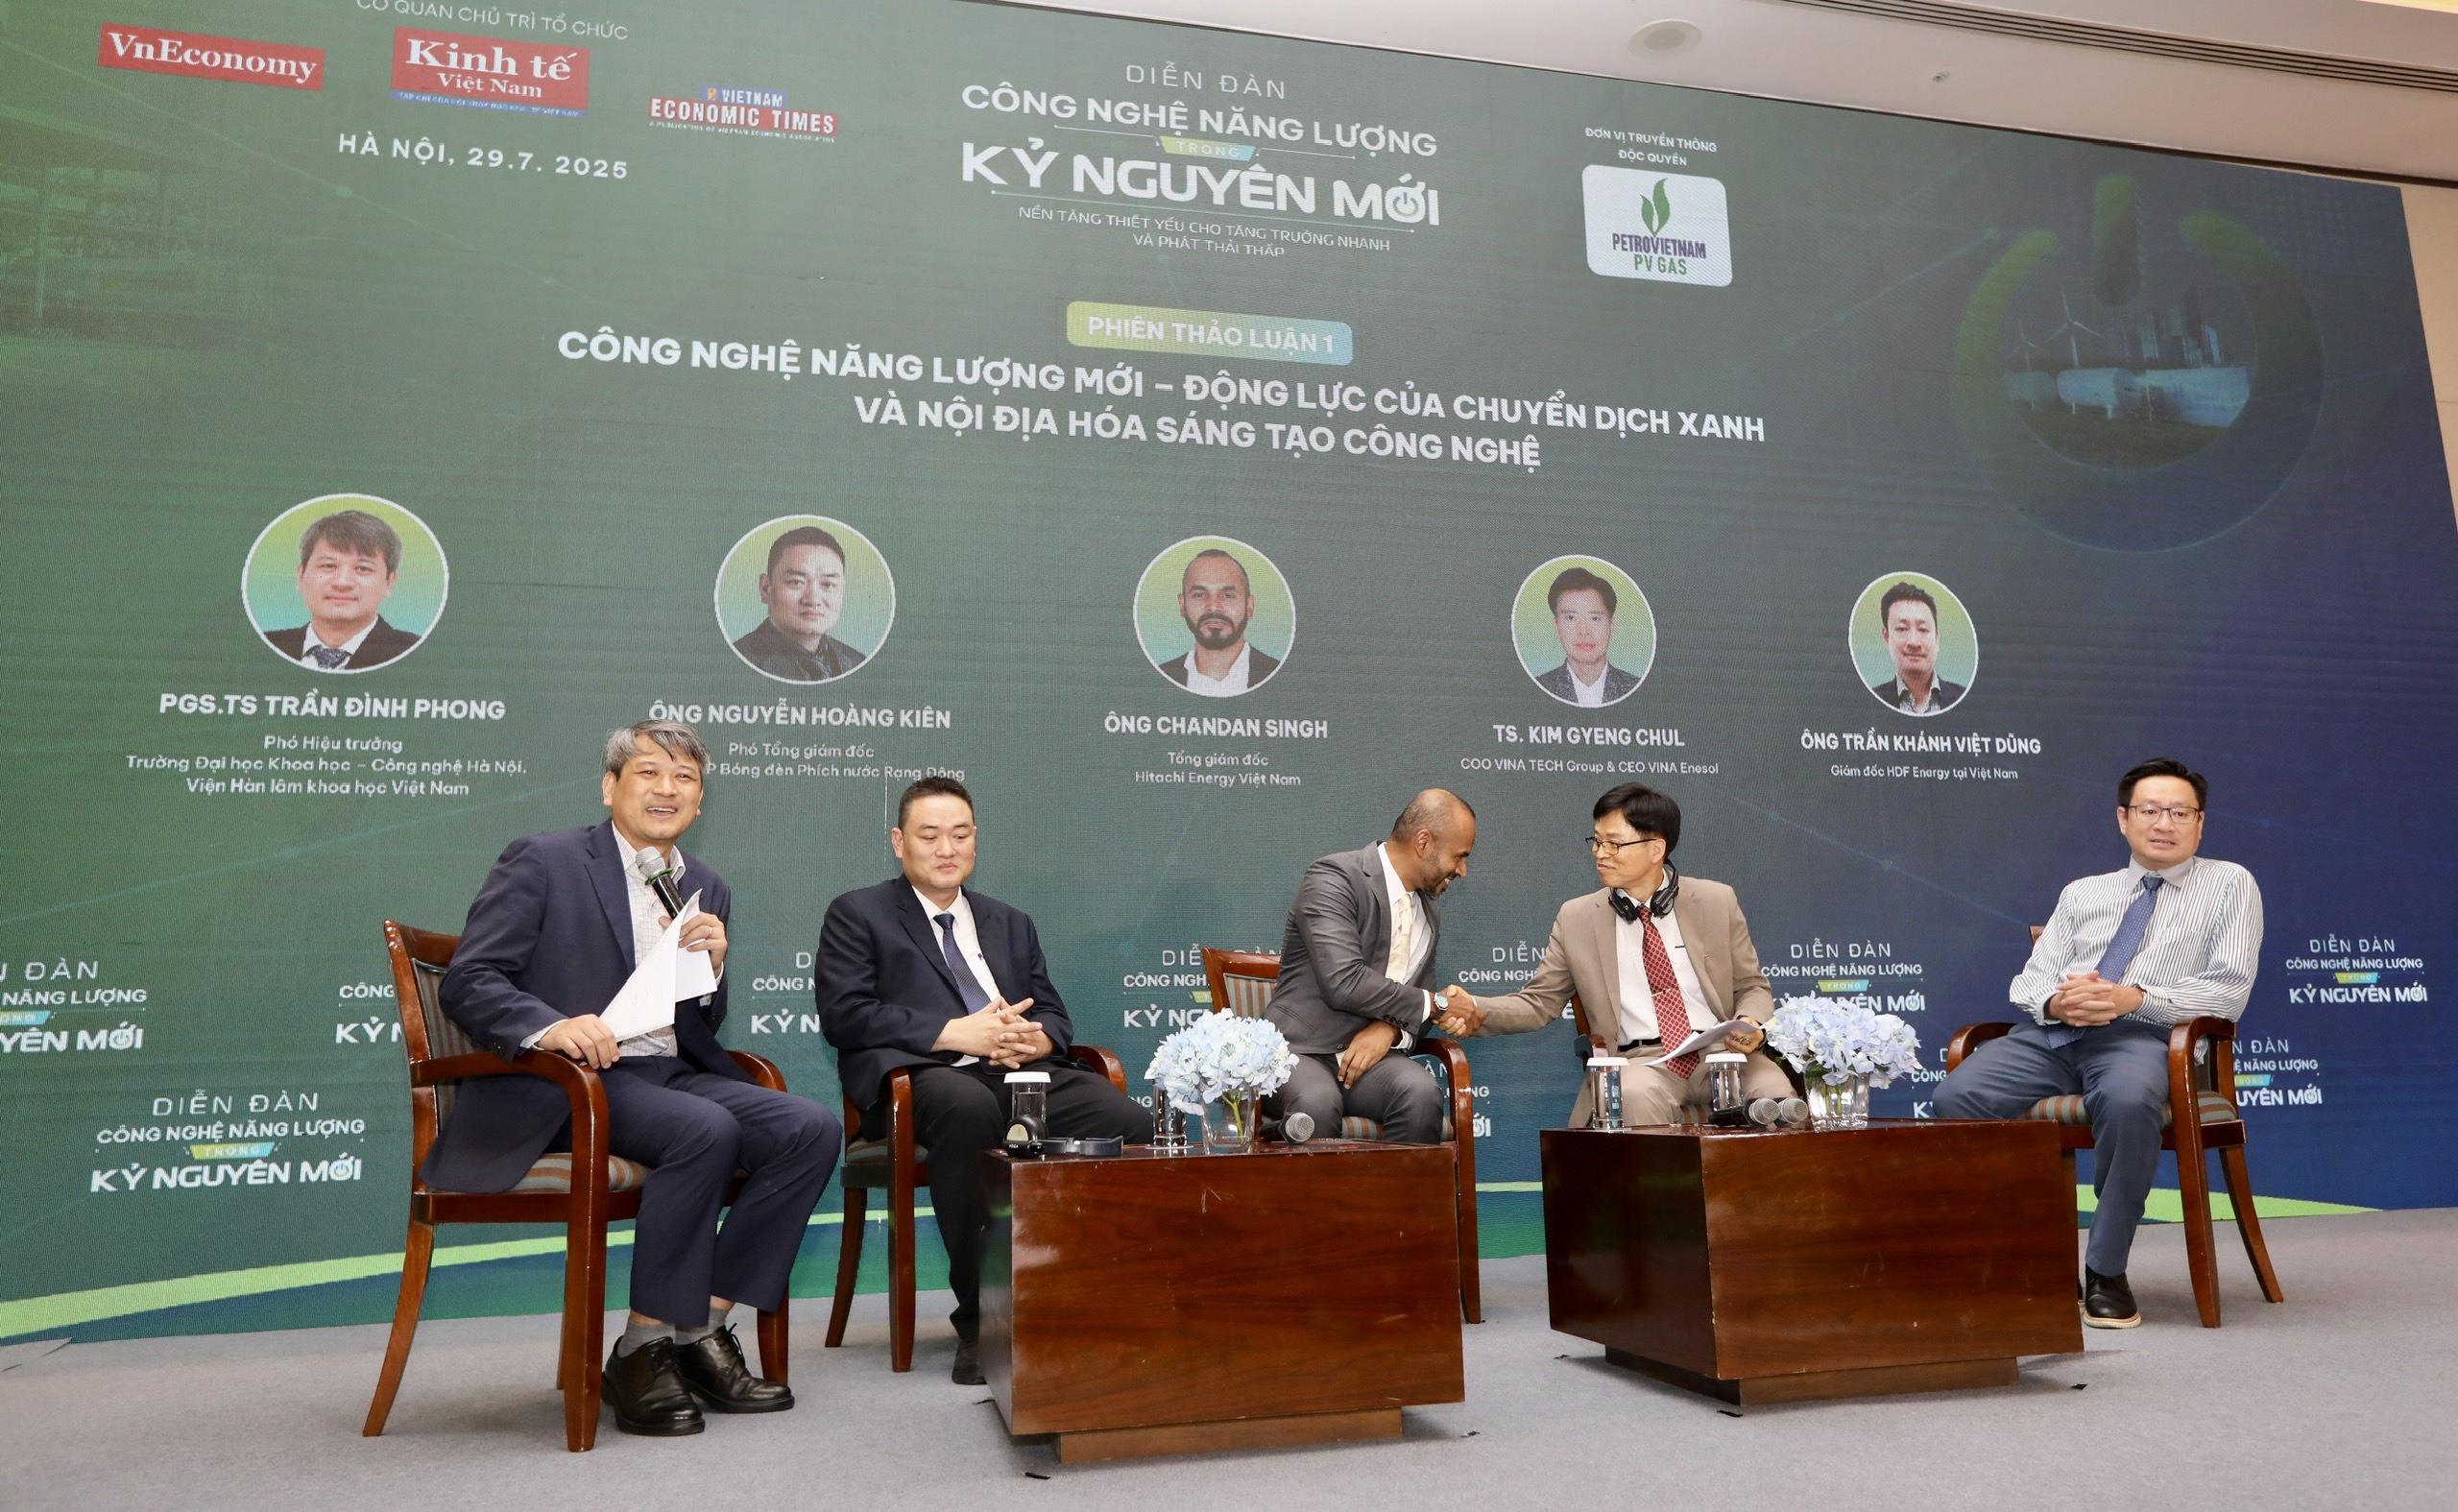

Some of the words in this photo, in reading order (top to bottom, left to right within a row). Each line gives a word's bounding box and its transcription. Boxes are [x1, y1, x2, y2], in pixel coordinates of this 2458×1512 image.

[458, 7, 500, 25] CHỦ
[506, 11, 536, 30] TRÌ
[541, 12, 566, 33] TỔ
[571, 20, 629, 40] CHỨC
[108, 32, 317, 84] VnEconomy
[405, 38, 518, 76] Kinh
[529, 52, 578, 81] tế
[437, 72, 484, 93] Việt
[490, 78, 542, 98] Nam
[1125, 60, 1203, 90] DIỄN
[1219, 72, 1286, 100] ĐÀN
[721, 88, 783, 108] VIETNAM
[650, 98, 760, 127] ECONOMIC
[771, 109, 834, 134] TIMES
[961, 82, 1077, 119] CÔNG
[1087, 98, 1188, 136] NGHỆ
[1199, 106, 1304, 141] NĂNG
[1313, 121, 1437, 157] LƯỢNG
[1176, 141, 1240, 157] TRONG
[1613, 132, 1626, 144] VỊ
[1676, 137, 1717, 153] THÔNG
[338, 131, 379, 156] HÀ
[392, 136, 455, 166] NỘI,
[555, 156, 628, 180] 2025
[1618, 149, 1645, 162] ĐỘC
[961, 137, 1059, 188] KỶ
[1072, 154, 1316, 213] NGUYÊN
[1333, 173, 1440, 226] MỚI
[1189, 222, 1221, 235] CHO
[1337, 235, 1390, 252] NHANH
[1612, 233, 1706, 259] PETROVIETNAM
[1634, 253, 1653, 273] PV
[1657, 256, 1687, 275] GAS
[1088, 315, 1165, 341] PHIÊN
[1170, 318, 1243, 347] THẢO
[1249, 327, 1318, 356] LUẬN
[1323, 334, 1334, 353] 1
[558, 325, 682, 366] CÔNG
[690, 339, 802, 381] NGHỆ
[810, 343, 924, 381] NĂNG
[932, 355, 1066, 396] LƯỢNG
[1074, 362, 1144, 397] MỚI
[1183, 369, 1289, 411] ĐỘNG
[1296, 381, 1367, 419] LỰC
[1373, 380, 1446, 419] CỦA
[1453, 388, 1587, 429] CHUYỂN
[1594, 405, 1671, 440] DỊCH
[1676, 411, 1766, 443] XANH
[854, 389, 907, 426] VÀ
[917, 395, 983, 438] NỘI
[992, 405, 1059, 443] ĐỊA
[1068, 404, 1148, 442] HÓA
[1155, 410, 1256, 447] SÁNG
[1264, 422, 1336, 459] TẠO
[1342, 423, 1443, 460] CÔNG
[1451, 434, 1541, 473] NGHỆ
[158, 693, 258, 715] PGS.TS
[265, 687, 338, 717] TRẦN
[344, 691, 408, 718] ĐÌNH
[413, 698, 507, 720] PHONG
[648, 699, 703, 723] ÔNG
[708, 698, 807, 725] NGUYỄN
[811, 704, 895, 727] HOÀNG
[900, 706, 951, 729] KIÊN
[1104, 710, 1152, 733] ÔNG
[1156, 716, 1261, 737] CHANDAN
[1265, 719, 1328, 739] SINGH
[264, 734, 299, 750] Phó
[302, 734, 340, 753] Hiệu
[1493, 725, 1524, 743] TS.
[1529, 726, 1562, 744] KIM
[1566, 727, 1631, 746] GYENG
[1635, 728, 1685, 747] CHUL
[1800, 729, 1839, 750] ÔNG
[1843, 727, 1890, 751] TRẦN
[1893, 731, 1952, 753] KHÁNH
[1954, 732, 1991, 756] VIỆT
[1995, 732, 2041, 755] DŨNG
[729, 742, 758, 756] Phó
[762, 740, 800, 759] Tổng
[803, 743, 842, 760] giám
[845, 742, 875, 758] đốc
[1168, 750, 1202, 767] Tổng
[1204, 752, 1240, 767] giám
[1241, 752, 1269, 766] đốc
[195, 756, 227, 773] Đại
[230, 756, 264, 774] học
[268, 756, 315, 771] Khoa
[319, 757, 351, 775] học
[371, 757, 418, 775] Công
[421, 758, 463, 776] nghệ
[467, 759, 491, 774] Hà
[720, 762, 760, 780] Bóng
[764, 762, 794, 778] đèn
[797, 764, 840, 778] Phích
[843, 765, 880, 779] nước
[1460, 758, 1492, 770] COO
[1494, 758, 1527, 771] VINA
[1529, 759, 1563, 772] TECH
[1566, 760, 1603, 775] Group
[1606, 761, 1616, 773] &
[1618, 761, 1646, 774] CEO
[1648, 762, 1677, 774] VINA
[1680, 762, 1719, 775] Enesol
[1830, 764, 1861, 778] Giám
[1863, 764, 1885, 778] đốc
[1887, 766, 1910, 778] HDF
[1913, 766, 1950, 780] Energy
[1953, 767, 1967, 780] tại
[1969, 767, 1991, 781] Việt
[1993, 768, 2018, 780] Nam
[185, 778, 227, 796] Viện
[270, 779, 303, 794] lâm
[306, 779, 350, 795] khoa
[354, 779, 387, 797] học
[392, 780, 425, 797] Việt
[430, 780, 470, 796] Nam
[1135, 771, 1185, 783] Hitachi
[1189, 772, 1236, 787] Energy
[1239, 772, 1266, 788] Việt
[1269, 774, 1301, 785] Nam
[1791, 937, 1839, 959] DIỄN
[1848, 940, 1891, 958] ĐÀN
[2309, 933, 2350, 953] DIỄN
[2359, 936, 2396, 952] ĐÀN
[1761, 963, 1799, 977] CÔNG
[1801, 963, 1837, 978] NGHỆ
[1878, 962, 1922, 977] LƯỢNG
[2285, 957, 2319, 970] CÔNG
[2321, 957, 2350, 972] NGHỆ
[2351, 956, 2383, 970] NĂNG
[2385, 957, 2423, 971] LƯỢNG
[752, 974, 804, 992] CÔNG
[1123, 972, 1170, 987] CÔNG
[71, 987, 147, 1007] LƯỢNG
[2289, 983, 2317, 1003] KỶ
[2320, 985, 2392, 1003] NGUYÊN
[750, 1008, 795, 1034] KỶ
[1123, 1003, 1163, 1028] KỶ
[335, 1016, 386, 1044] KỶ
[2251, 1036, 2289, 1053] ĐÀN
[2278, 1059, 2318, 1073] LƯỢNG
[153, 1089, 233, 1116] DIỄN
[249, 1090, 319, 1113] ĐÀN
[96, 1124, 161, 1143] CÔNG
[166, 1120, 225, 1143] NGHỆ
[229, 1119, 289, 1139] NĂNG
[293, 1118, 366, 1139] LƯỢNG
[90, 1163, 148, 1192] KỶ
[152, 1159, 291, 1189] NGUYÊN
